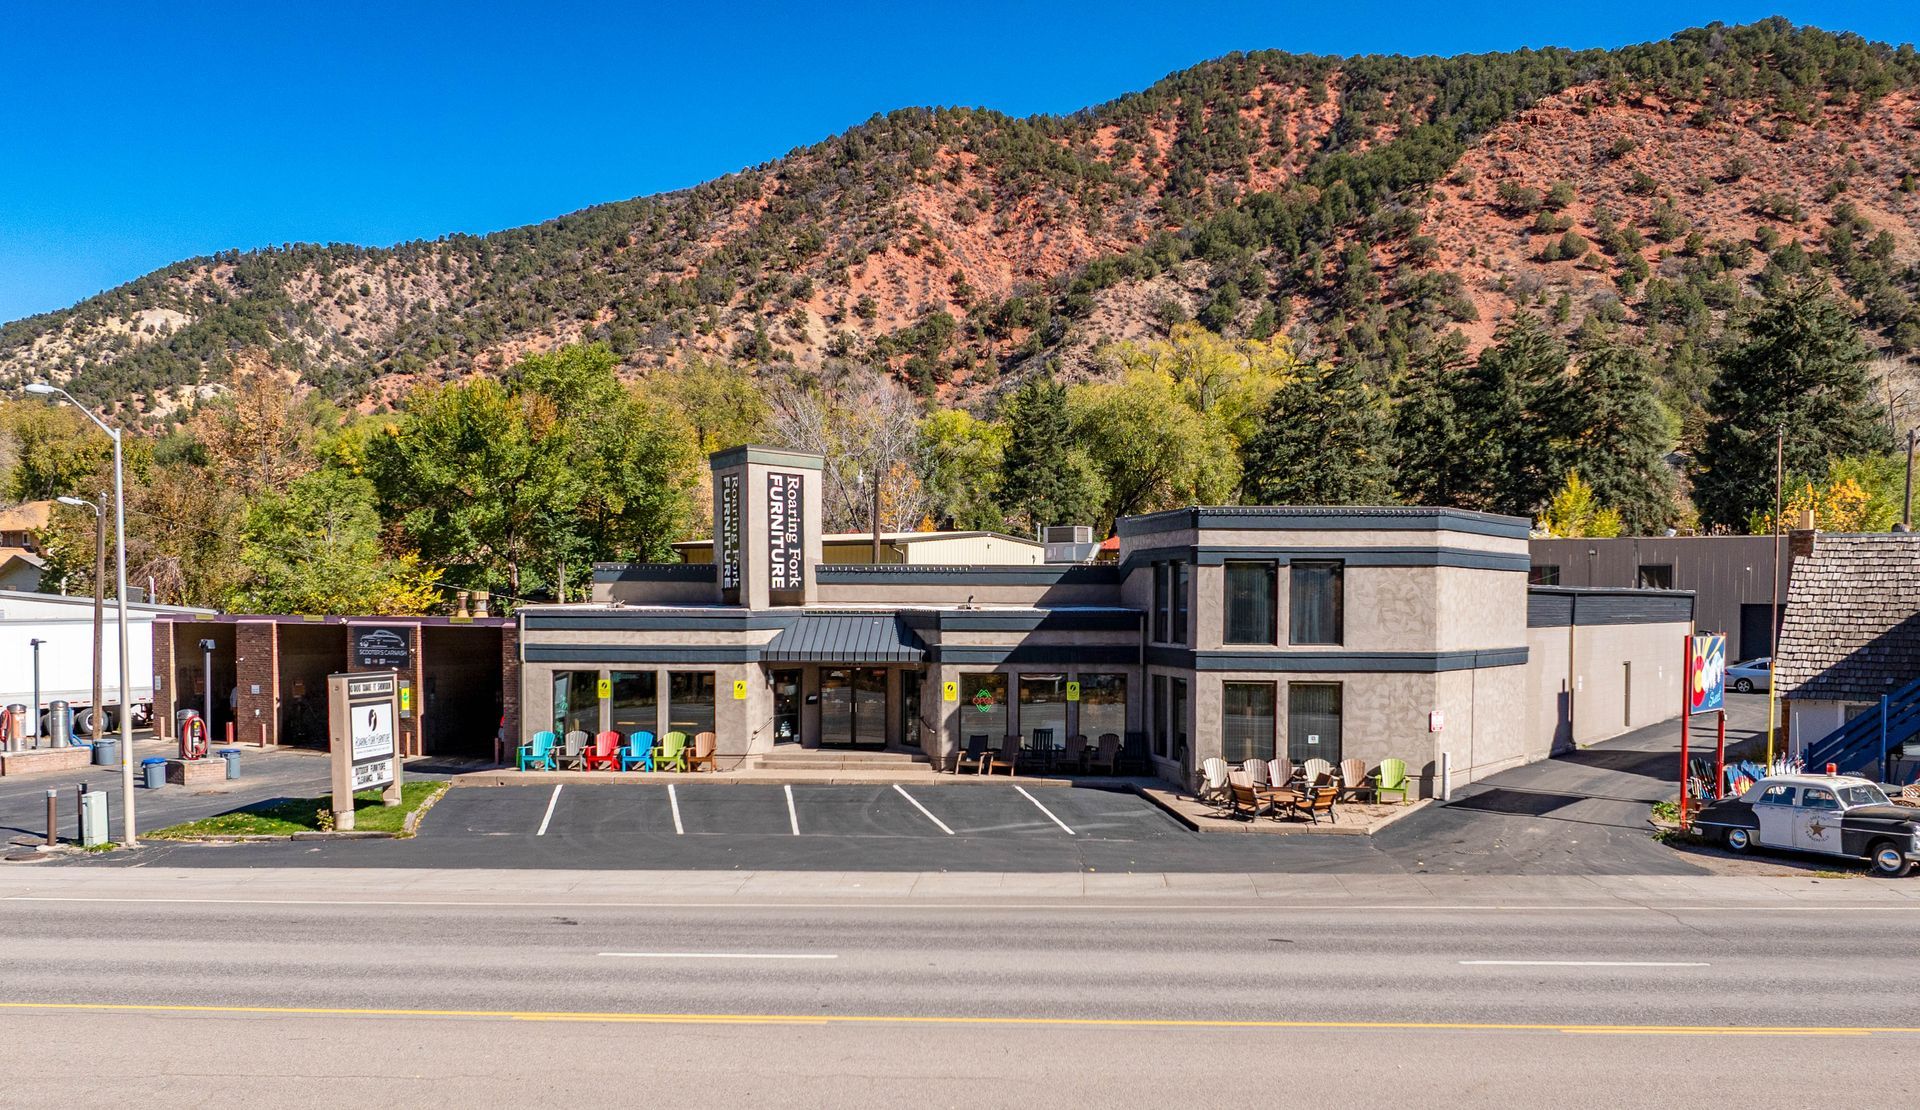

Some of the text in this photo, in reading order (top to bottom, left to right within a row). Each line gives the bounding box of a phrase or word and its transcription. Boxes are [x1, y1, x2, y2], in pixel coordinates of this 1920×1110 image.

[722, 476, 732, 589] FURNITURE
[731, 476, 740, 588] Roaring Fork
[769, 474, 785, 589] FURNITURE
[785, 476, 802, 588] Roaring Fork
[972, 697, 994, 705] OPEN
